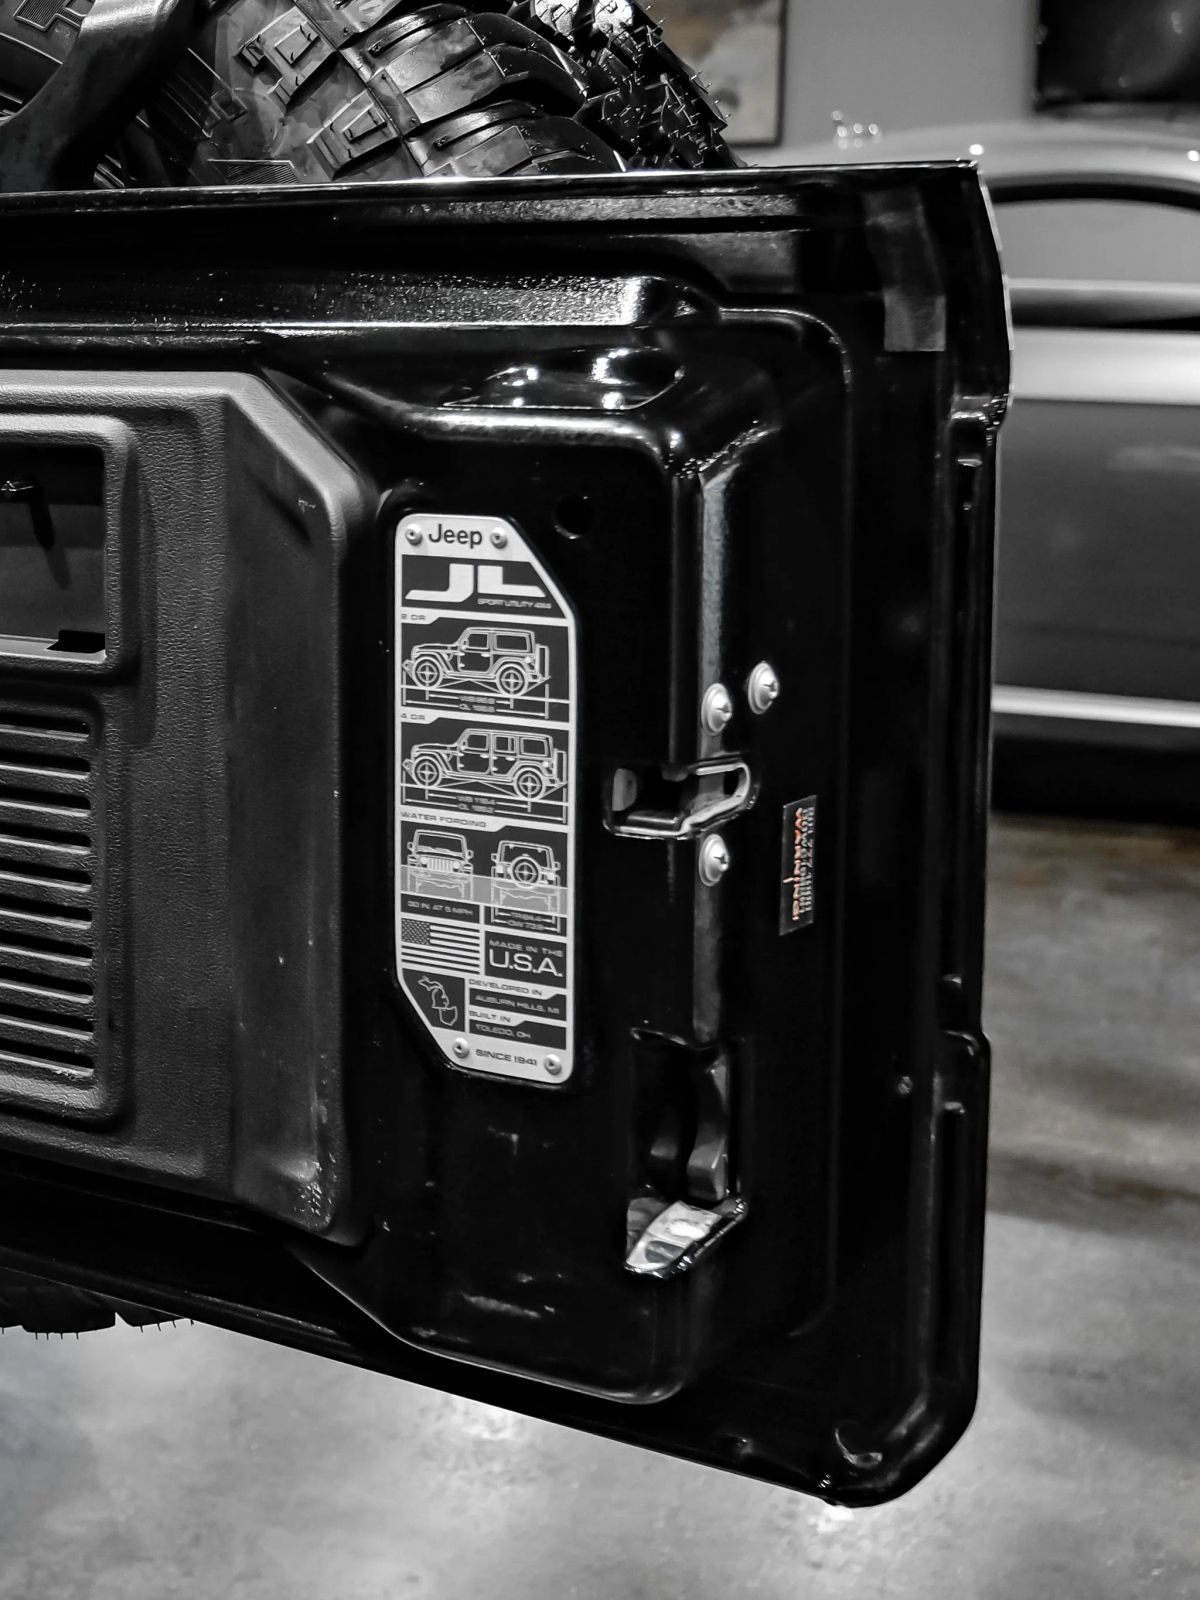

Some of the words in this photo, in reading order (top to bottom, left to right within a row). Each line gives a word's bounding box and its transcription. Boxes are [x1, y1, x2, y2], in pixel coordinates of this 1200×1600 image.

[428, 523, 483, 549] Jeep
[405, 563, 546, 603] JL
[400, 811, 437, 821] WATER
[439, 816, 487, 828] FORDING
[489, 939, 522, 951] MADE
[525, 945, 538, 954] IN
[541, 947, 564, 958] THE
[489, 949, 563, 978] U.S.A.
[468, 978, 530, 995] DEVELOPED
[532, 989, 543, 997] IN
[475, 994, 515, 1008] AUBURN
[469, 1010, 496, 1021] BUILT
[500, 1015, 511, 1023] IN
[475, 1048, 512, 1062] SINCE
[514, 1055, 537, 1066] 1941
